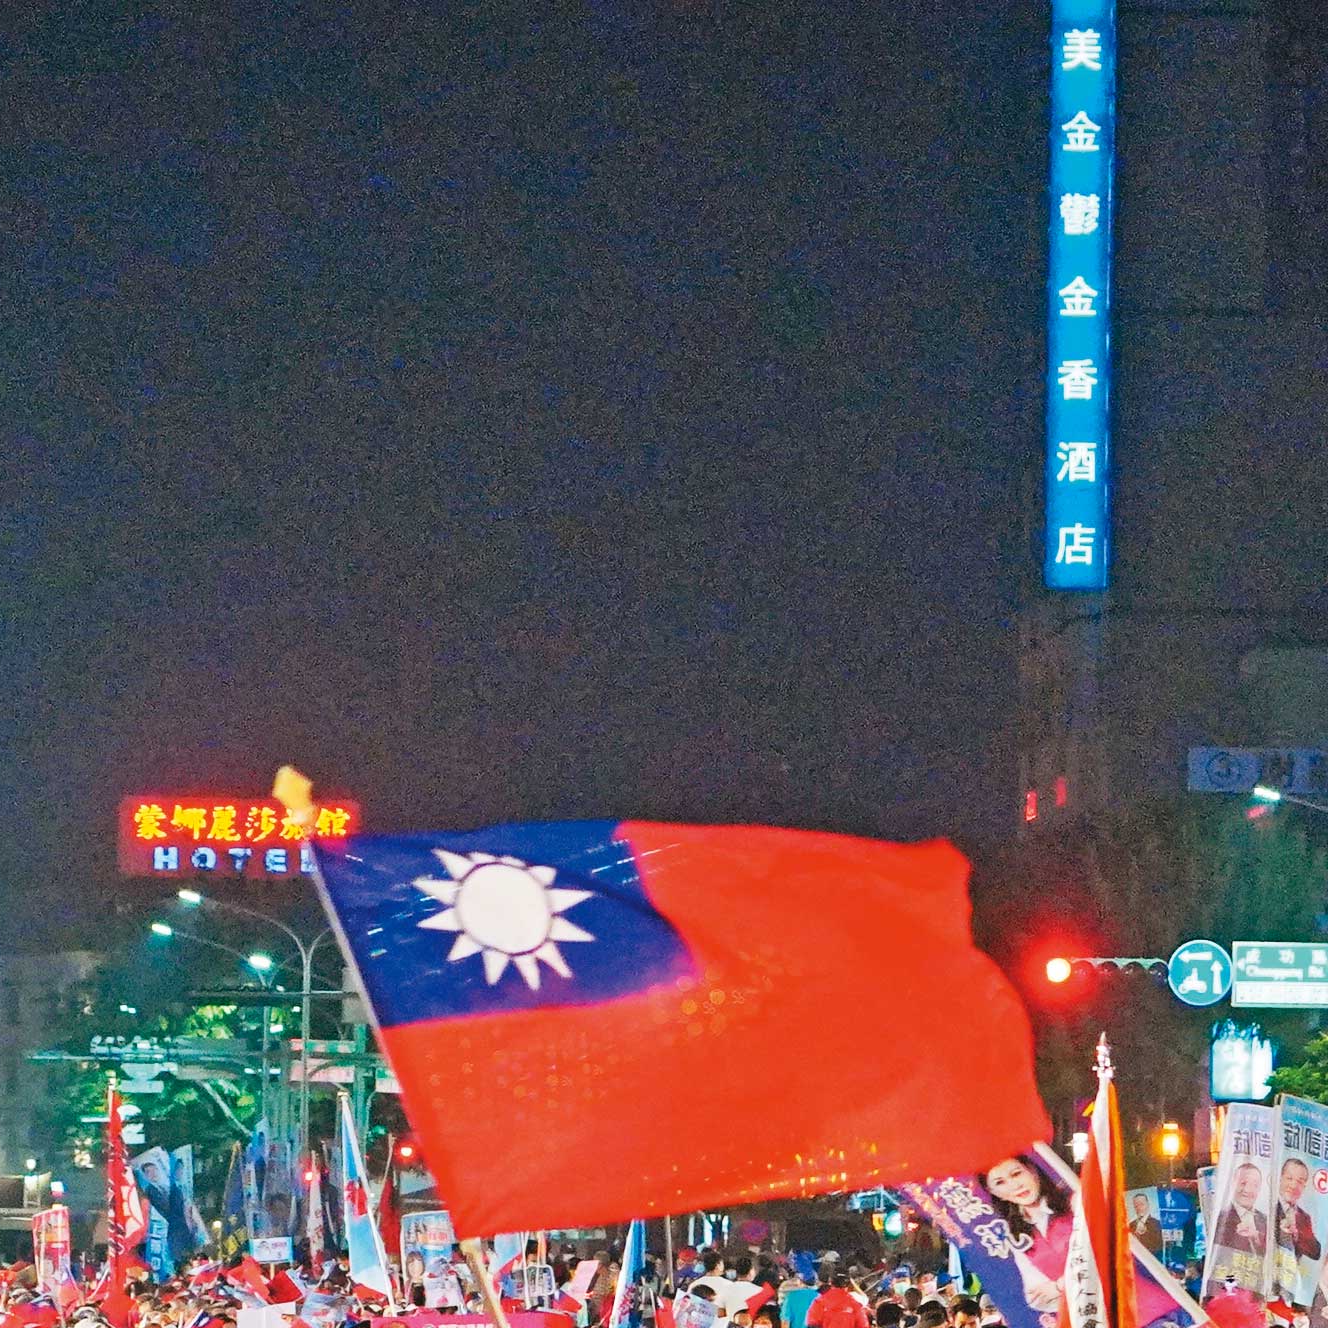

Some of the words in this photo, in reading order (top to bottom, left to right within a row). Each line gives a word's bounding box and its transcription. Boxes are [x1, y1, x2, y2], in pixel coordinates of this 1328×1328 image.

[1055, 28, 1103, 566] 美金鬱金香酒店
[153, 846, 318, 874] HOTEL
